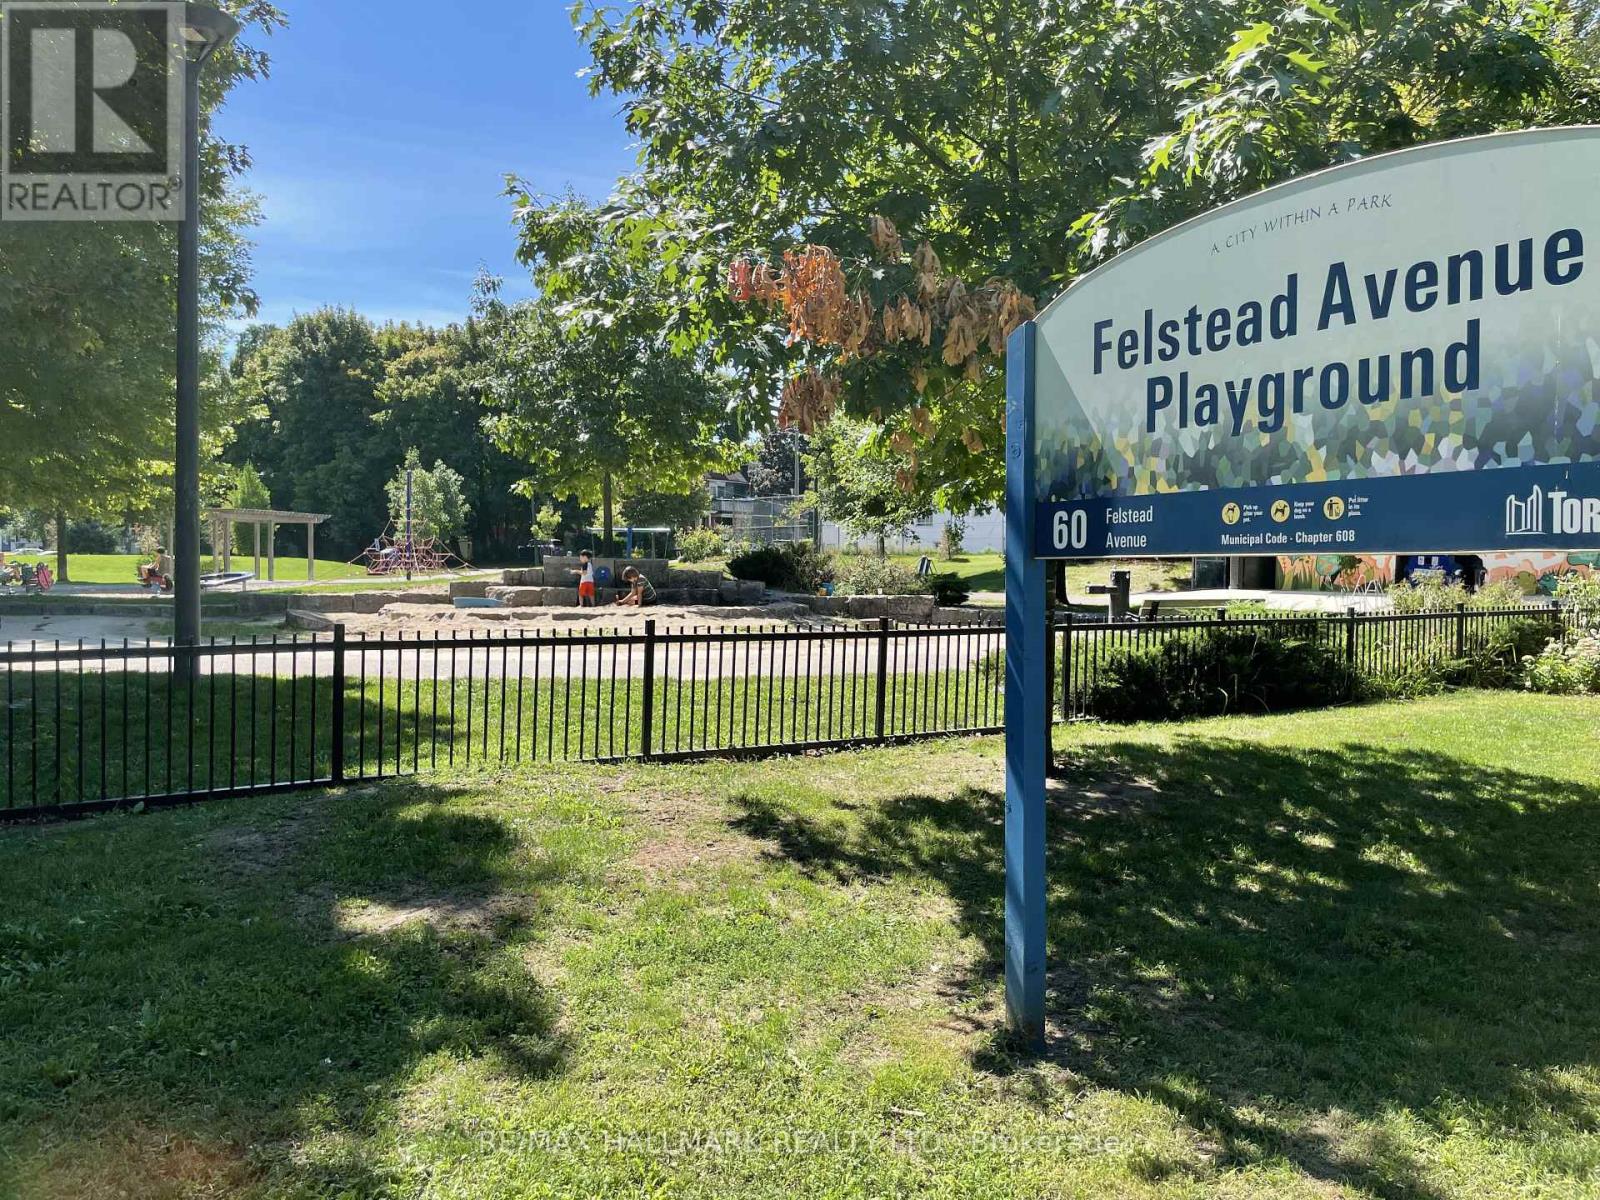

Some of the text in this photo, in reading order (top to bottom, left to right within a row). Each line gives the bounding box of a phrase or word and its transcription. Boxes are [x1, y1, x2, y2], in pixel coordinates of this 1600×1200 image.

[1210, 194, 1392, 256] A CITY WITHIN A PARK
[1093, 227, 1584, 375] Felstead Avenue
[1146, 318, 1481, 437] Playground
[1053, 509, 1088, 550] 60
[1106, 501, 1153, 524] Felstead
[1105, 532, 1147, 548] Avenue
[1221, 532, 1263, 547] Municipal
[1265, 532, 1288, 544] Code
[1295, 530, 1333, 545] Chapter
[1335, 530, 1355, 542] 608
